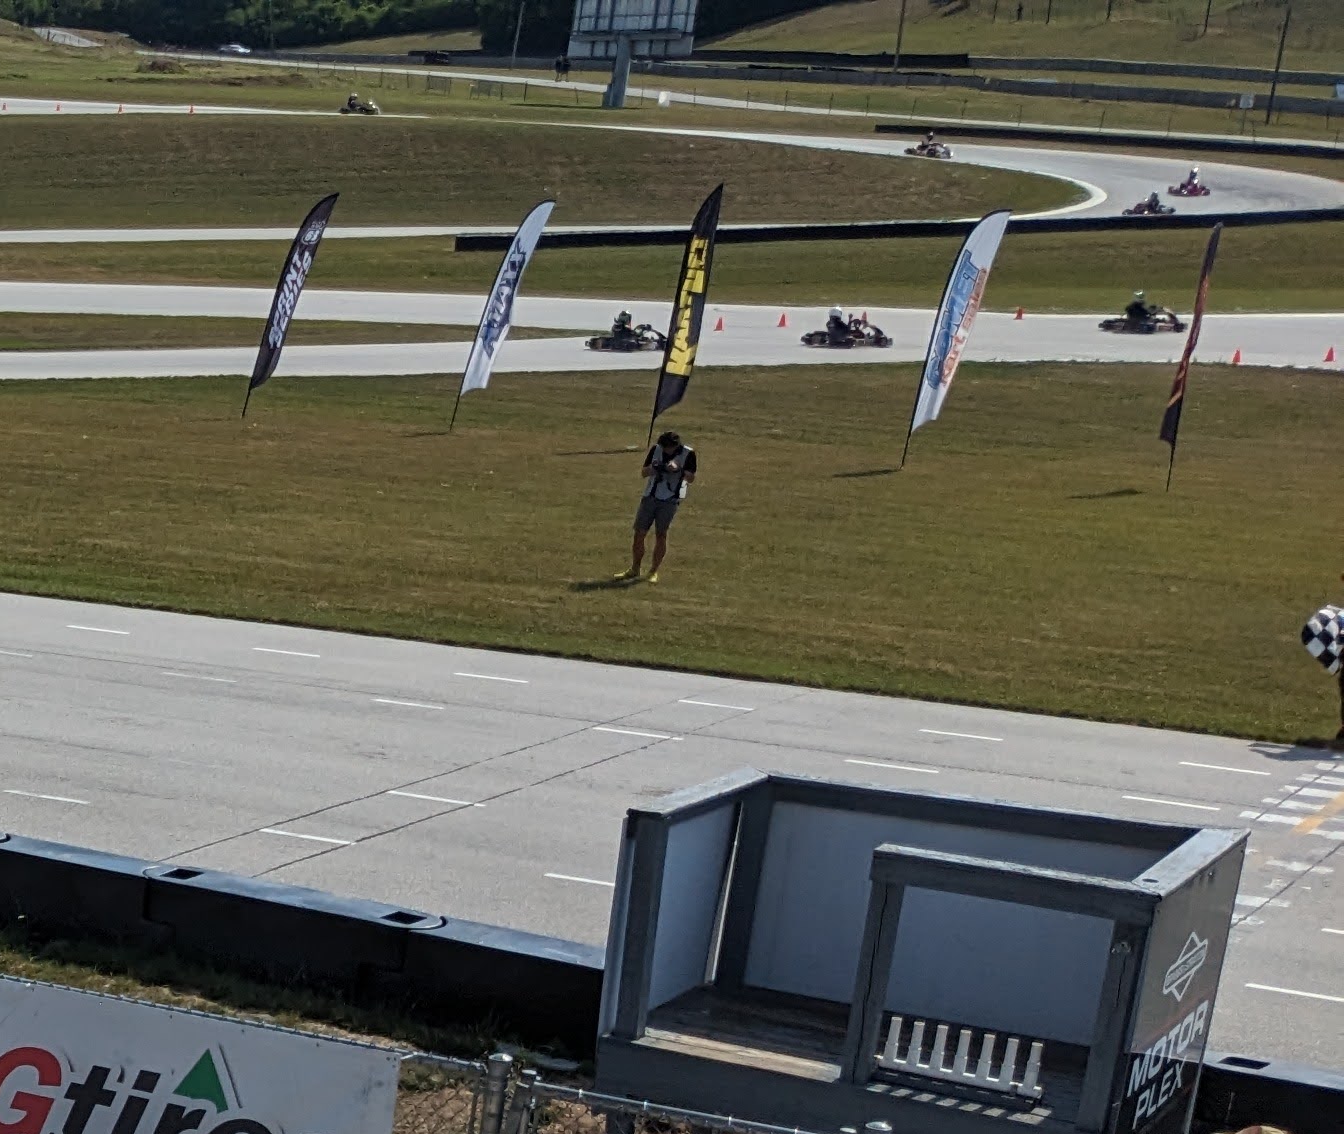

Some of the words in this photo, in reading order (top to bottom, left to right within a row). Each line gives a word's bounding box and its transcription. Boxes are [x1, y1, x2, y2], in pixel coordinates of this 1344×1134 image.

[927, 249, 979, 389] COMET
[1126, 1000, 1209, 1098] MOTOR
[1132, 1055, 1187, 1131] PLEX
